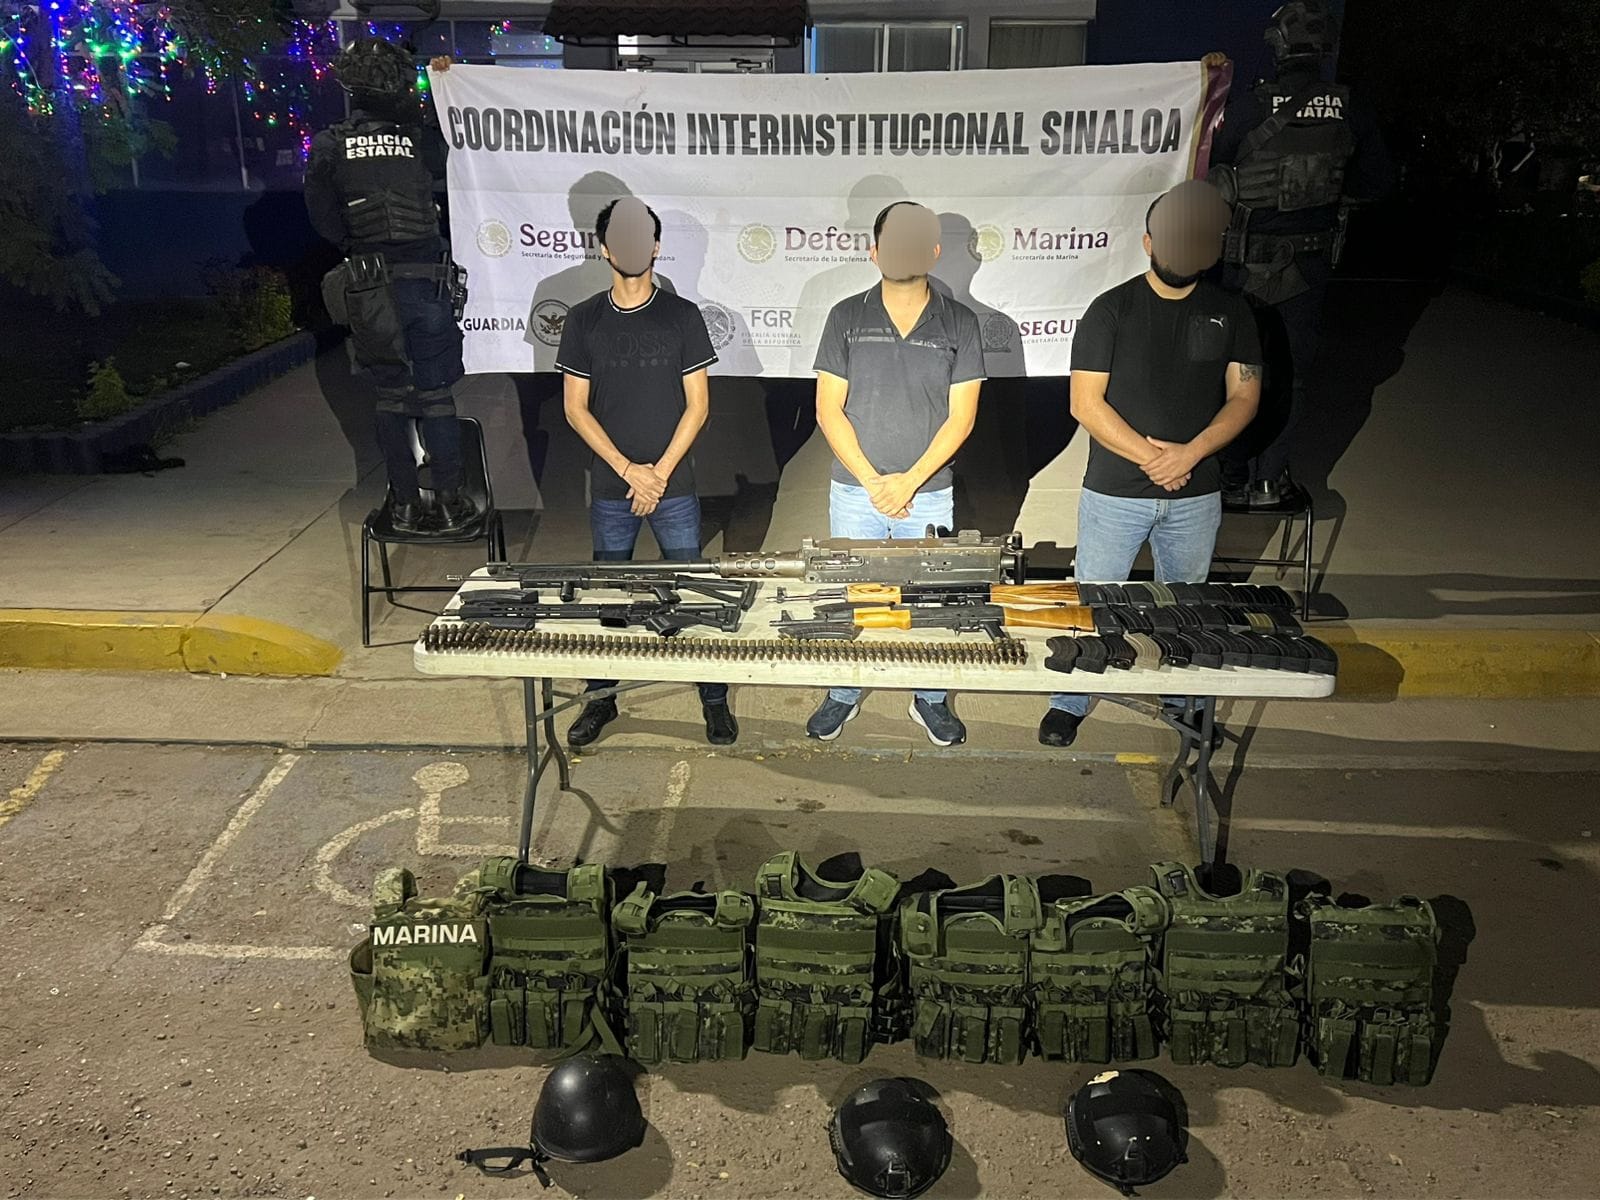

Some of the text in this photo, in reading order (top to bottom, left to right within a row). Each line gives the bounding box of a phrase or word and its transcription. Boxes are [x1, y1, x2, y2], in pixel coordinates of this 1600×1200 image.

[1272, 94, 1343, 108] PCÍA
[447, 103, 1181, 157] COORDINACIÓN INTERINSTITUCIONAL SINALOA
[346, 145, 415, 160] ESTATAL
[1011, 226, 1109, 251] Marina
[563, 252, 597, 261] Seguridad
[839, 255, 868, 263] Defensa
[463, 317, 526, 332] GUARDIA
[751, 309, 793, 328] FGR
[373, 924, 477, 946] MARINA
